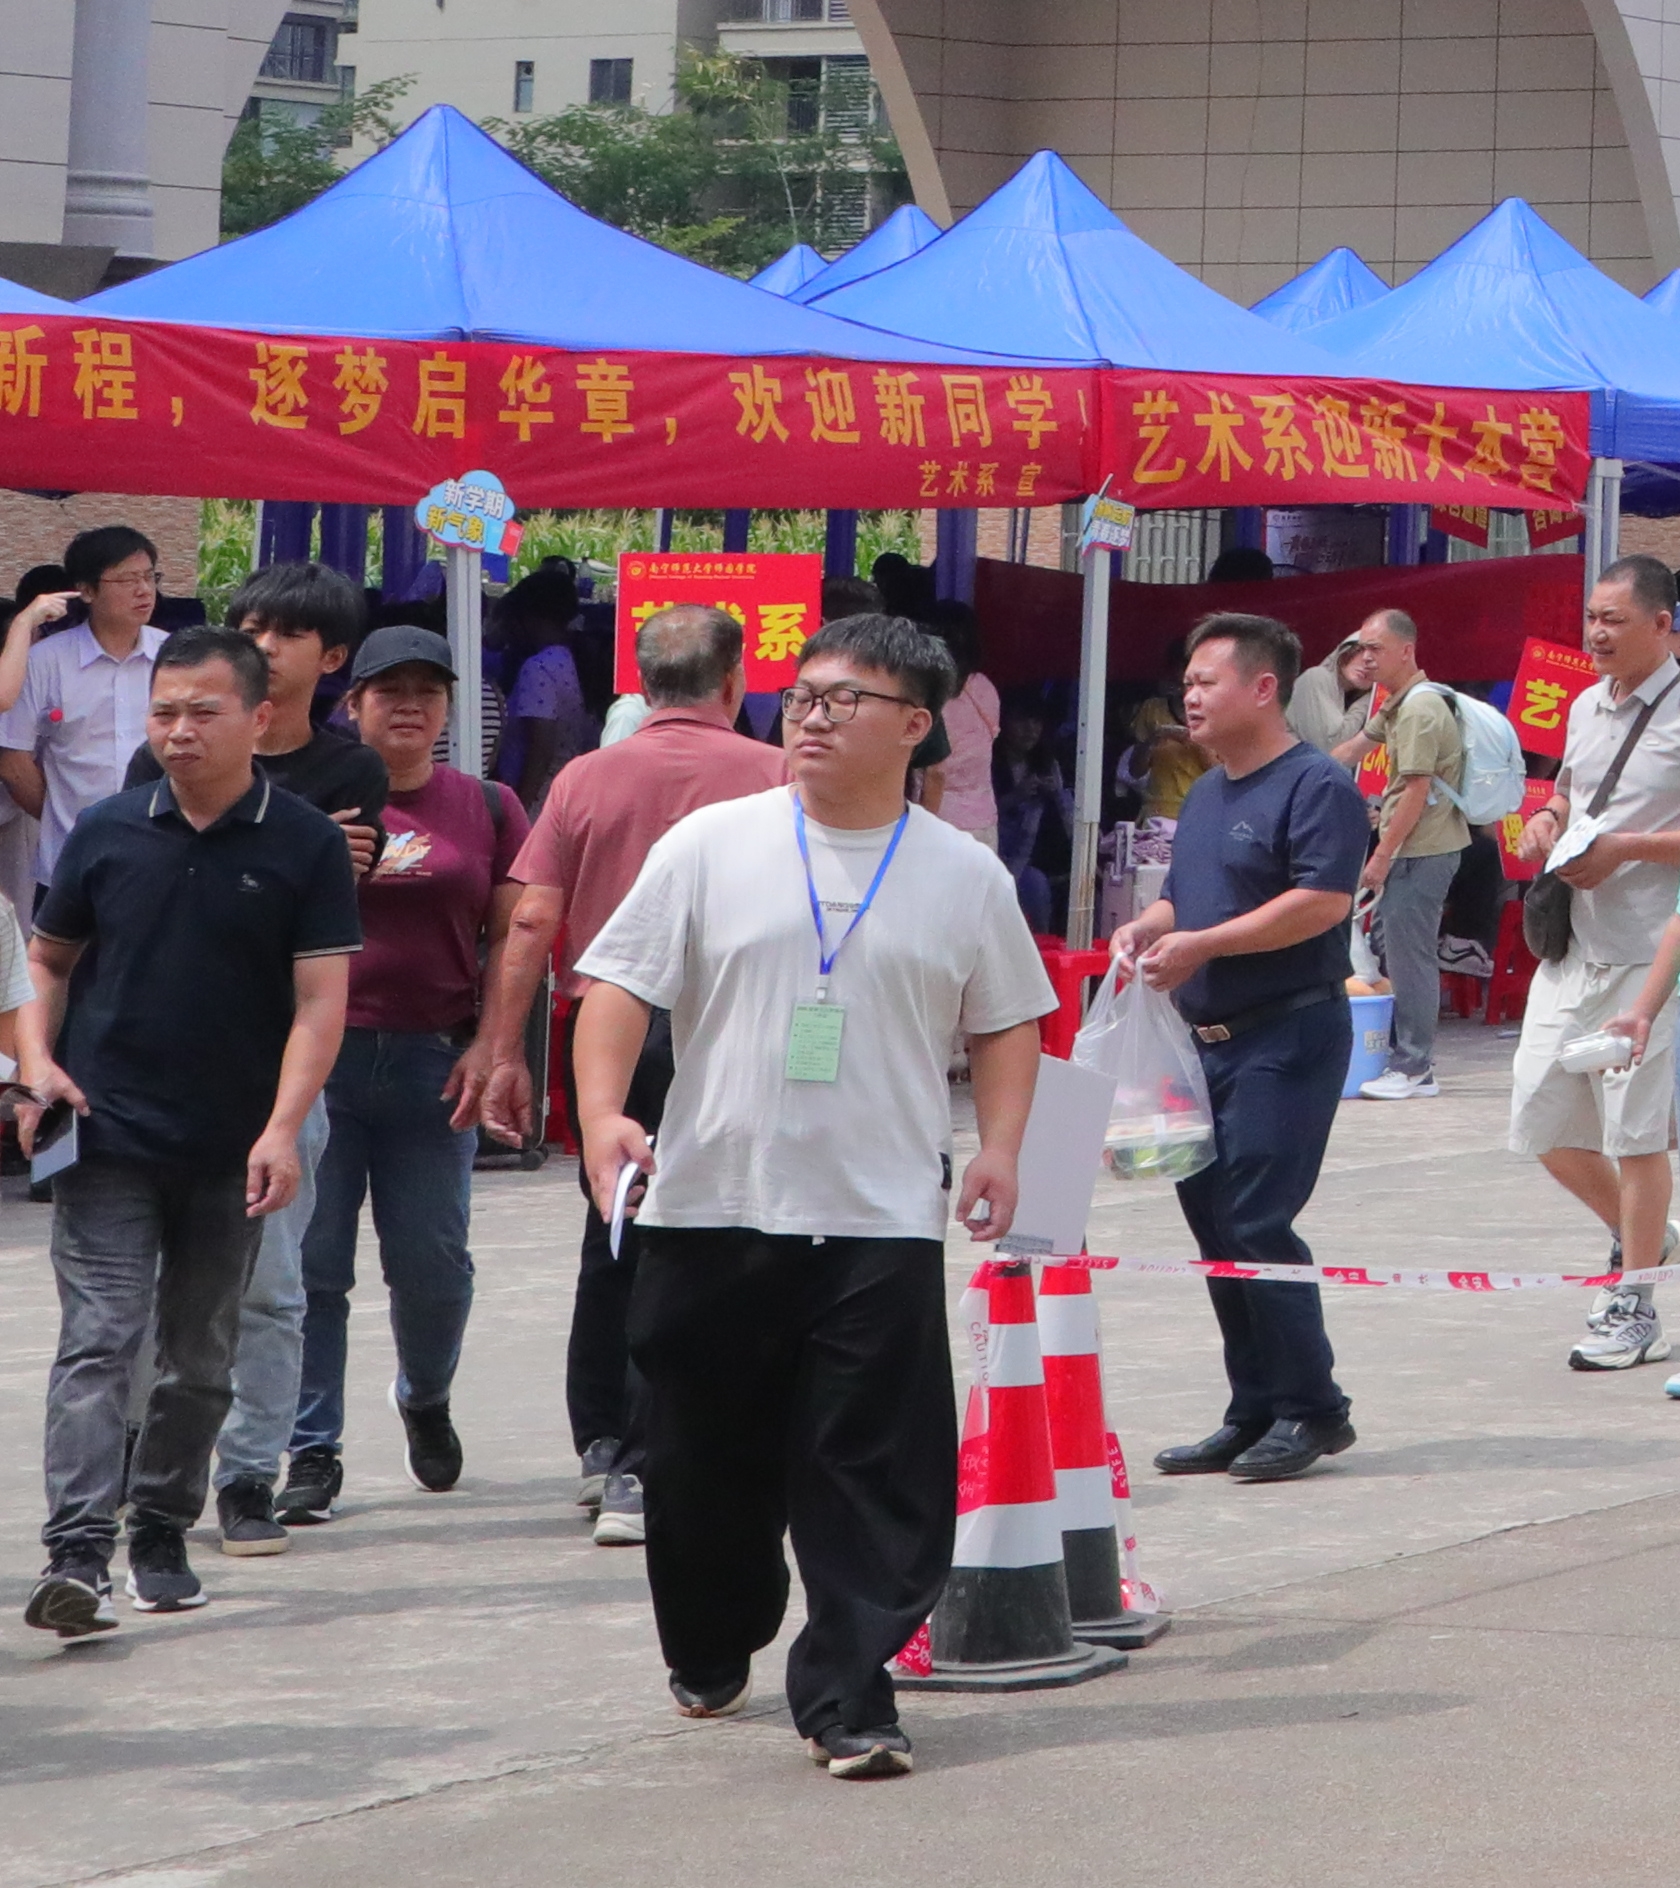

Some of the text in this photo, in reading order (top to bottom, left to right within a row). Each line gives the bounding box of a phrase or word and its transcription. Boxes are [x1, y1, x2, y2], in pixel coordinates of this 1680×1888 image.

[1132, 390, 1564, 493] 艺术系迎新大本营
[918, 460, 1043, 498] 艺术系 宣
[443, 478, 506, 519] 新学期
[426, 505, 485, 543] 新气象
[904, 1631, 929, 1663] SAF
